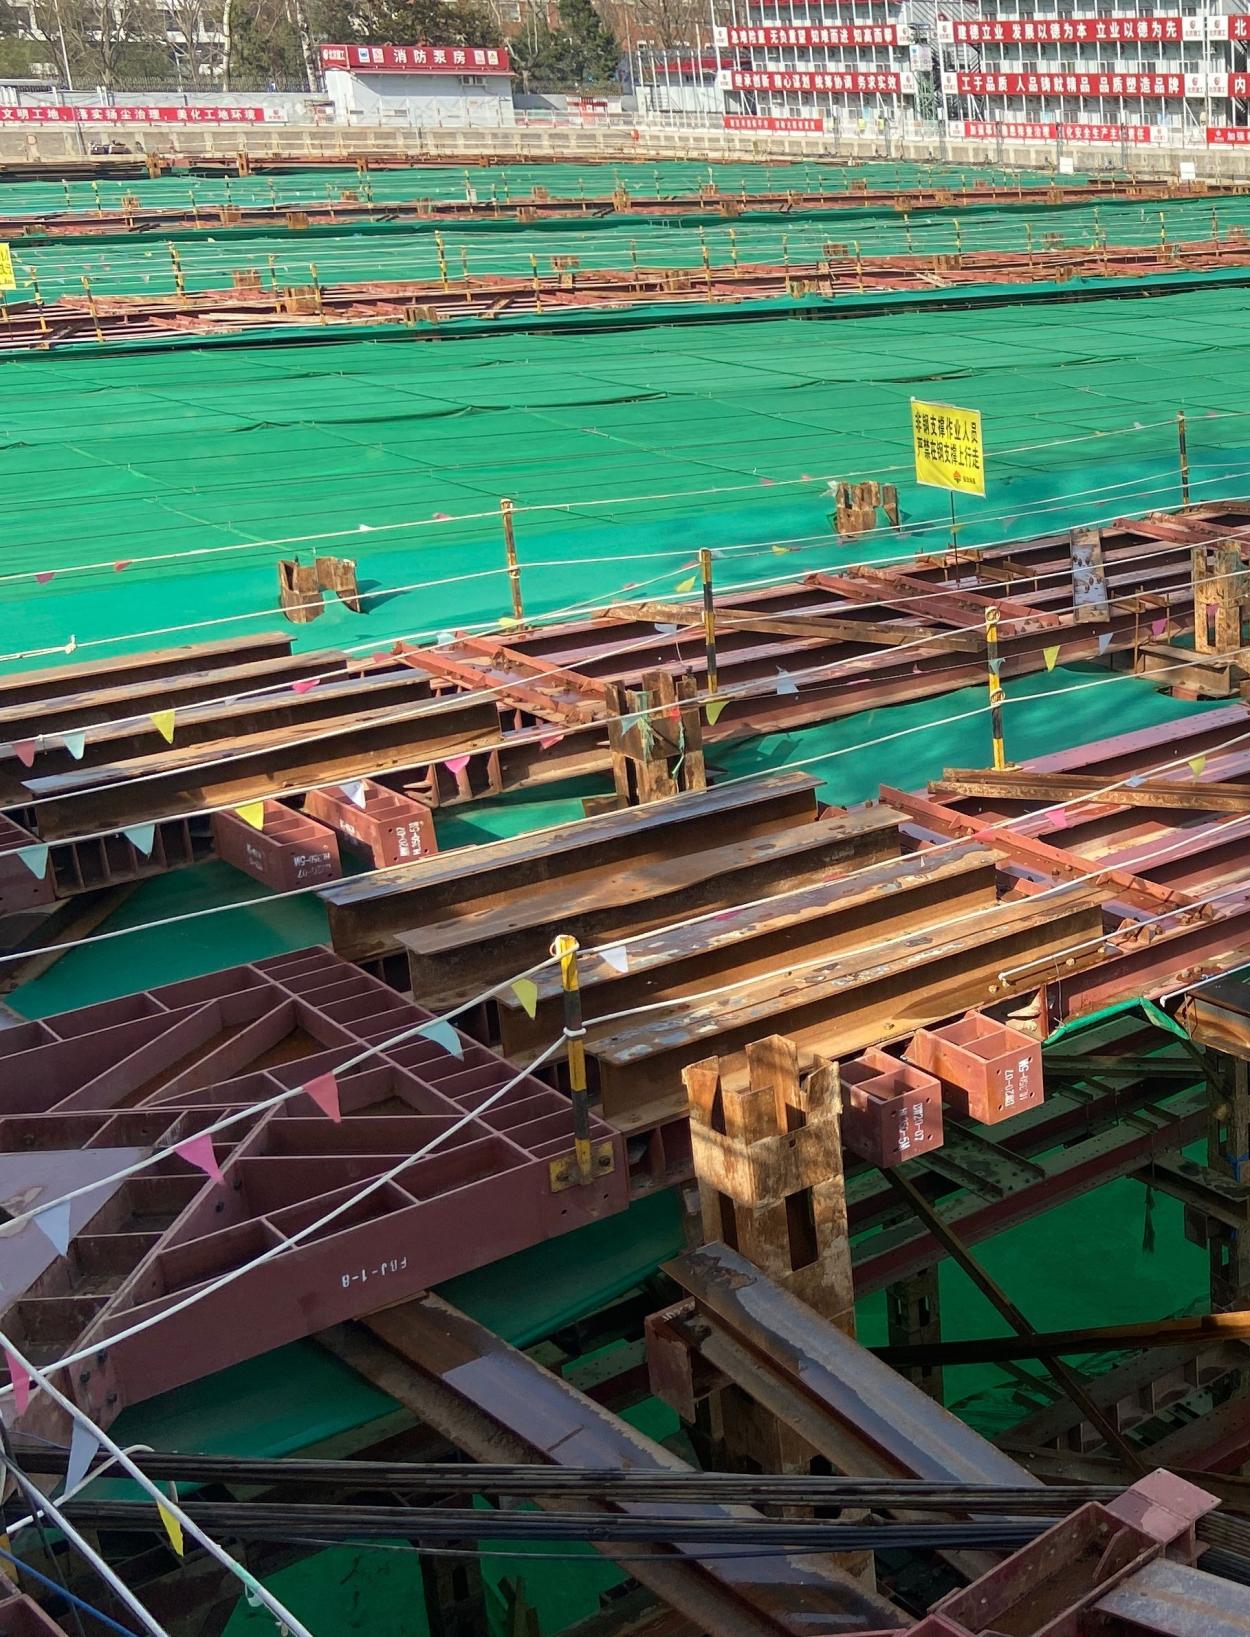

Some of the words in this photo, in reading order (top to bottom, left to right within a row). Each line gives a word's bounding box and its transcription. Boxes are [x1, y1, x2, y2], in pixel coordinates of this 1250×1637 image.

[957, 24, 1004, 40] 建德立业
[1012, 22, 1087, 40] 发展以德为本
[1096, 21, 1177, 38] 立业以德为先
[393, 49, 466, 65] 消防泵房
[961, 76, 1008, 92] 工于品质
[1016, 76, 1090, 92] 人品铸就精品
[1099, 77, 1179, 93] 品质塑造品牌
[914, 411, 978, 443] 非钢支撑作业人员
[917, 436, 980, 469] 严禁在钢支撑上行走
